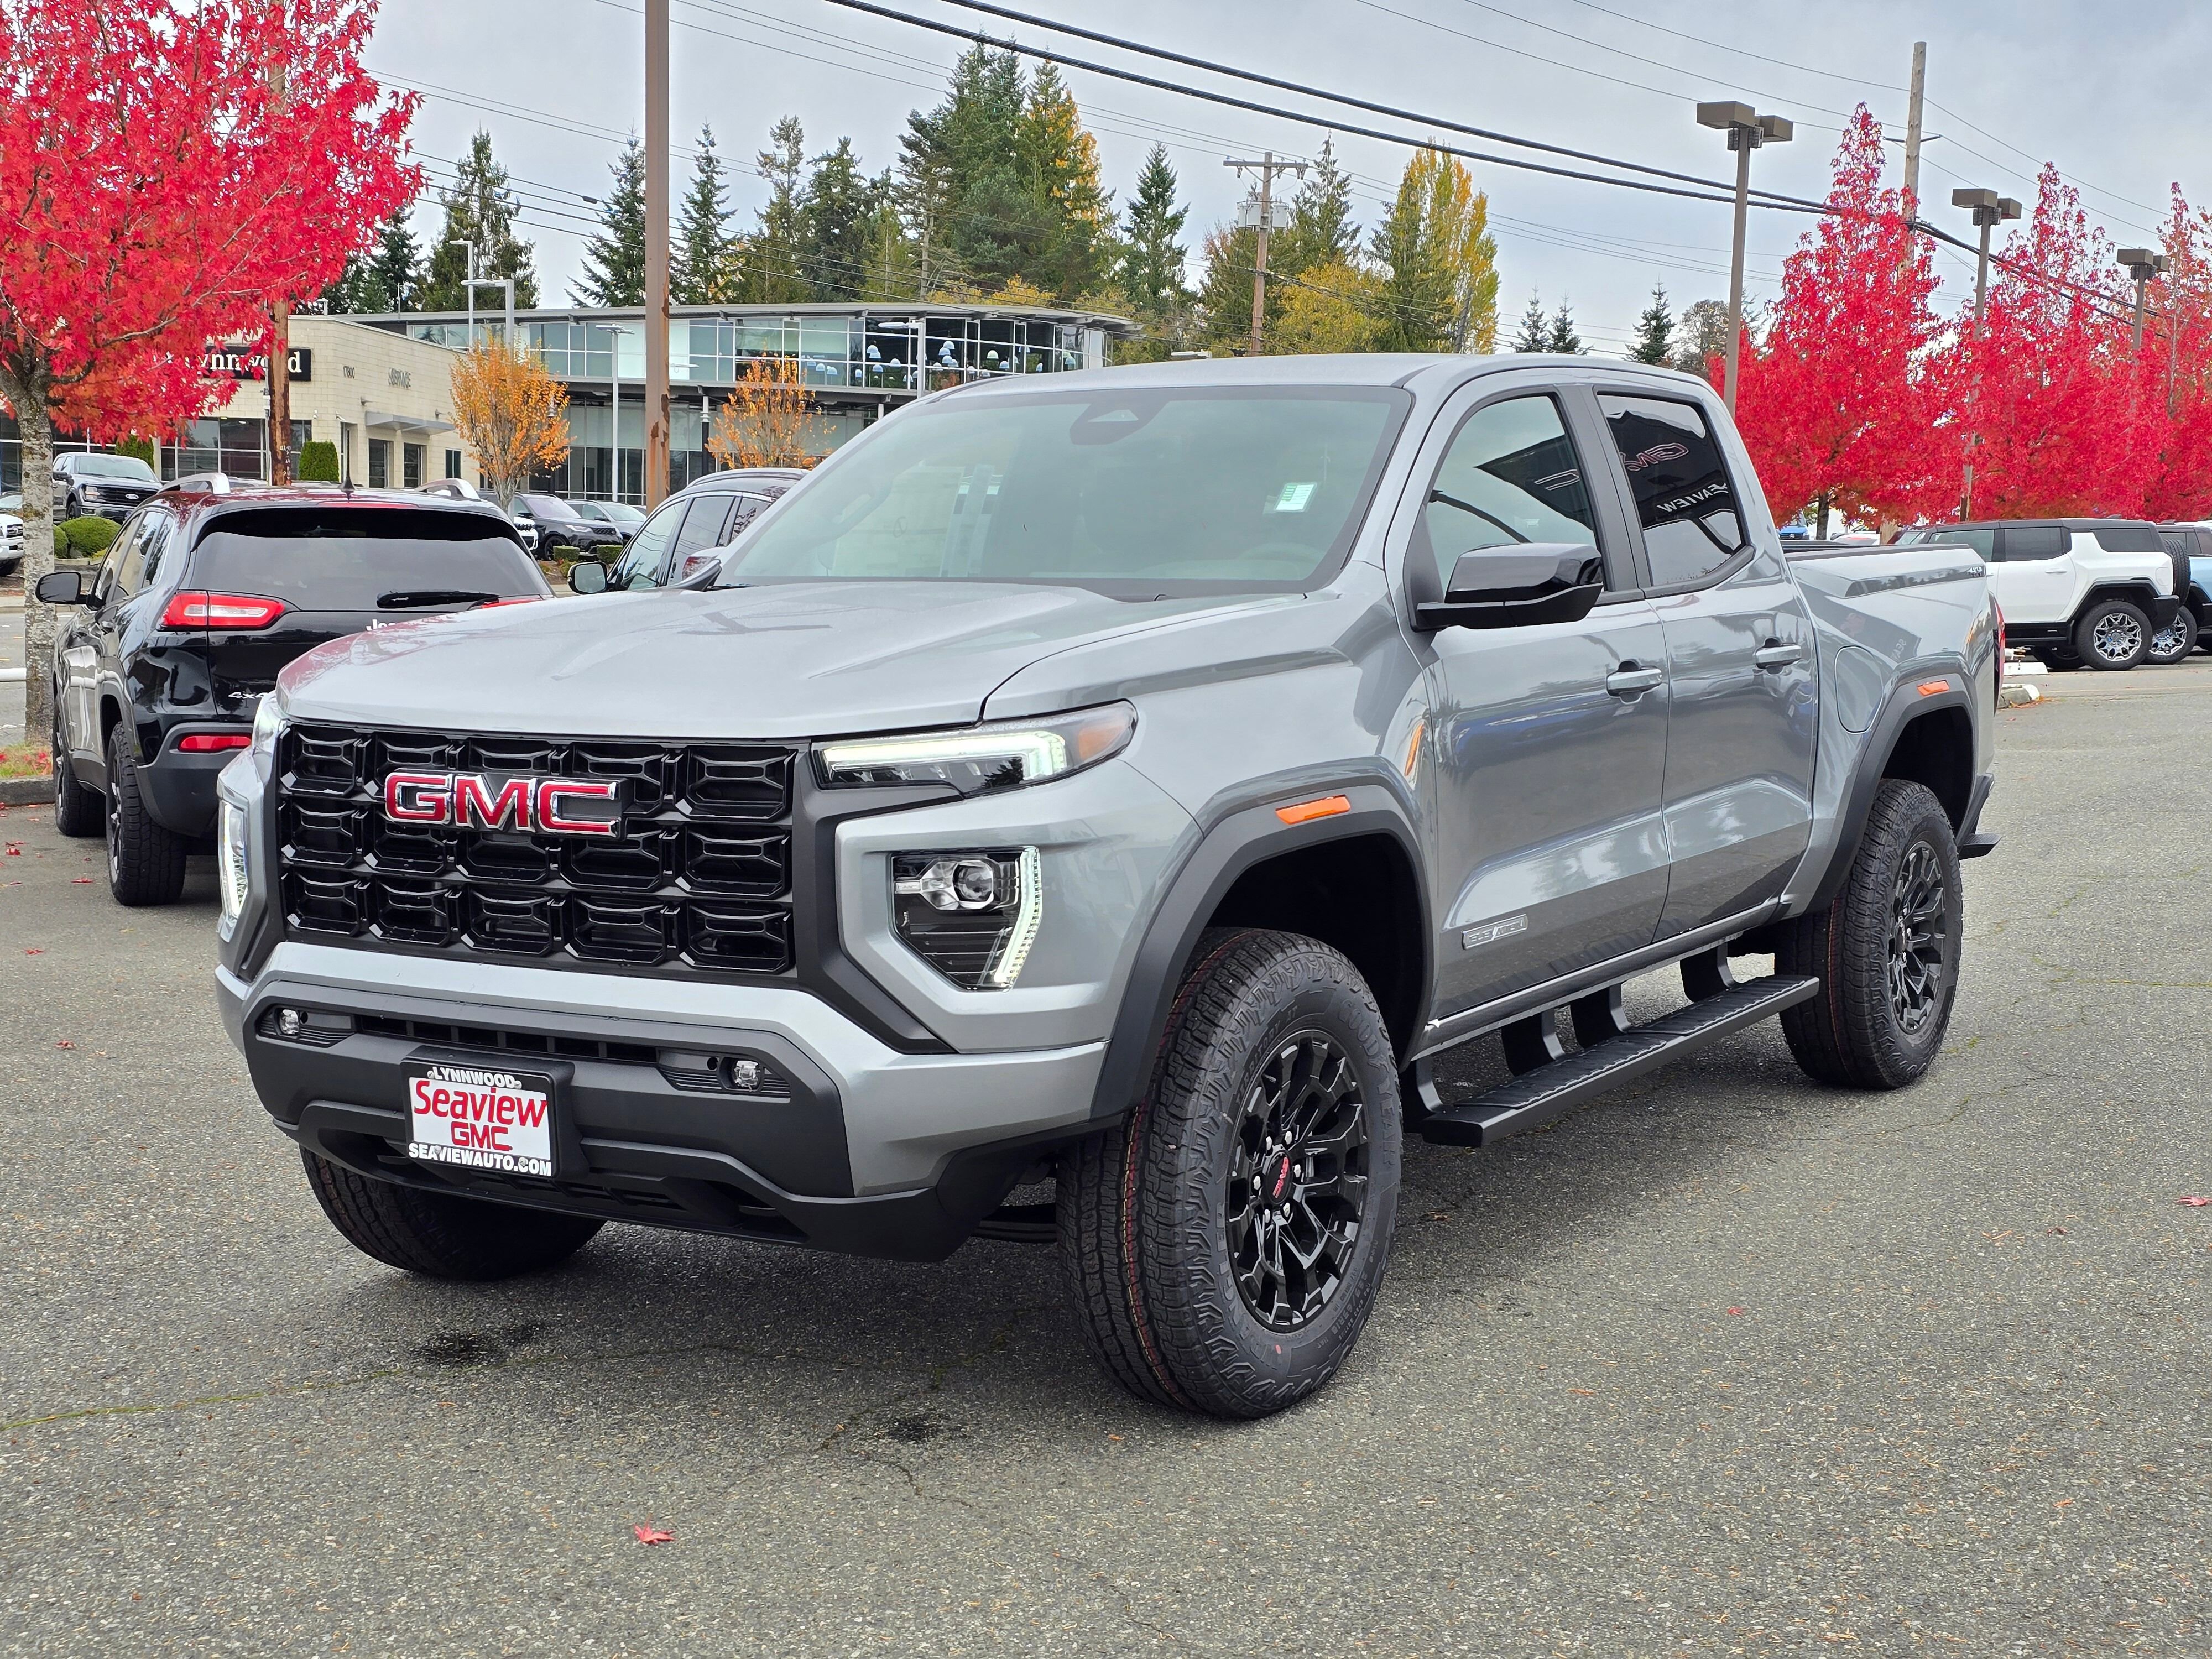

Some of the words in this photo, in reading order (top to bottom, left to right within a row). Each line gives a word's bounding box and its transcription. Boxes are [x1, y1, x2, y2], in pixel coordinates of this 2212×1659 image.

[384, 771, 617, 837] GMC
[432, 1066, 515, 1088] LYNNWOOD
[414, 1079, 549, 1128] Seaview
[451, 1121, 513, 1152] GMC
[408, 1142, 552, 1177] SEAVIEWAUTO.COM
